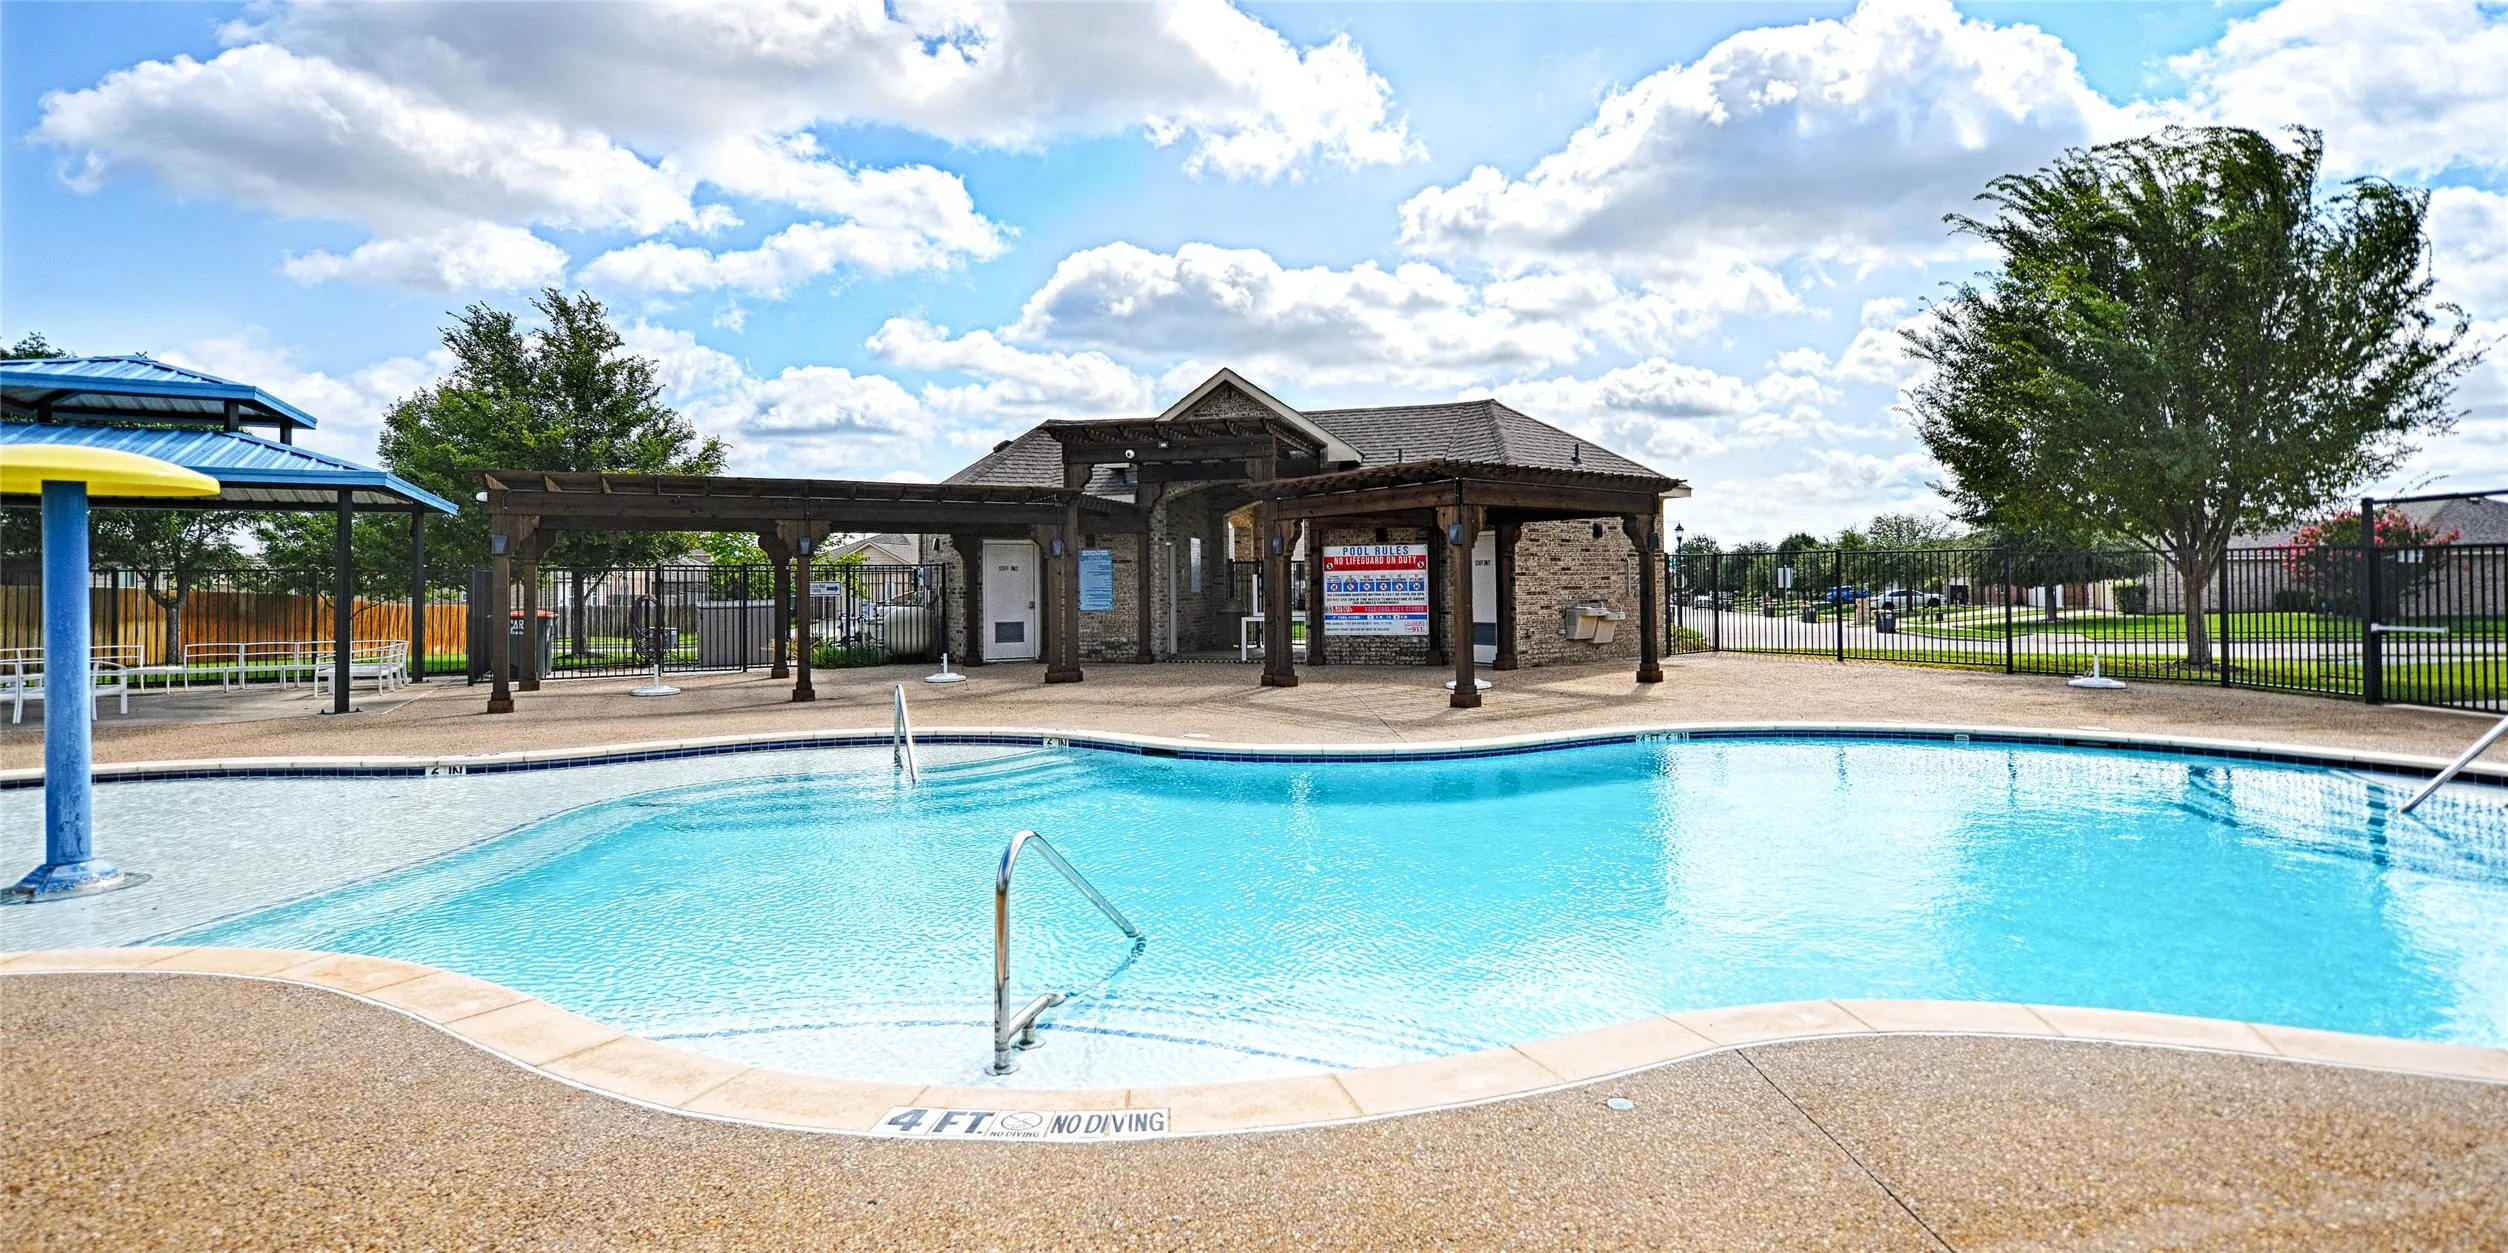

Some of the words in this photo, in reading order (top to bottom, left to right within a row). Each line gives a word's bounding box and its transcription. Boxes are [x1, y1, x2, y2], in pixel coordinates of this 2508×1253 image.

[1343, 547, 1369, 556] POOL
[1375, 545, 1409, 555] RULES
[1334, 557, 1343, 565] NO
[1346, 556, 1384, 565] LIFEGUARD
[1386, 556, 1396, 564] ON
[1398, 555, 1417, 564] DUTY
[448, 766, 463, 775] IN
[888, 1108, 929, 1132] 4
[932, 1110, 995, 1134] FT.
[1050, 1113, 1082, 1134] NO
[1084, 1112, 1165, 1134] DIVING
